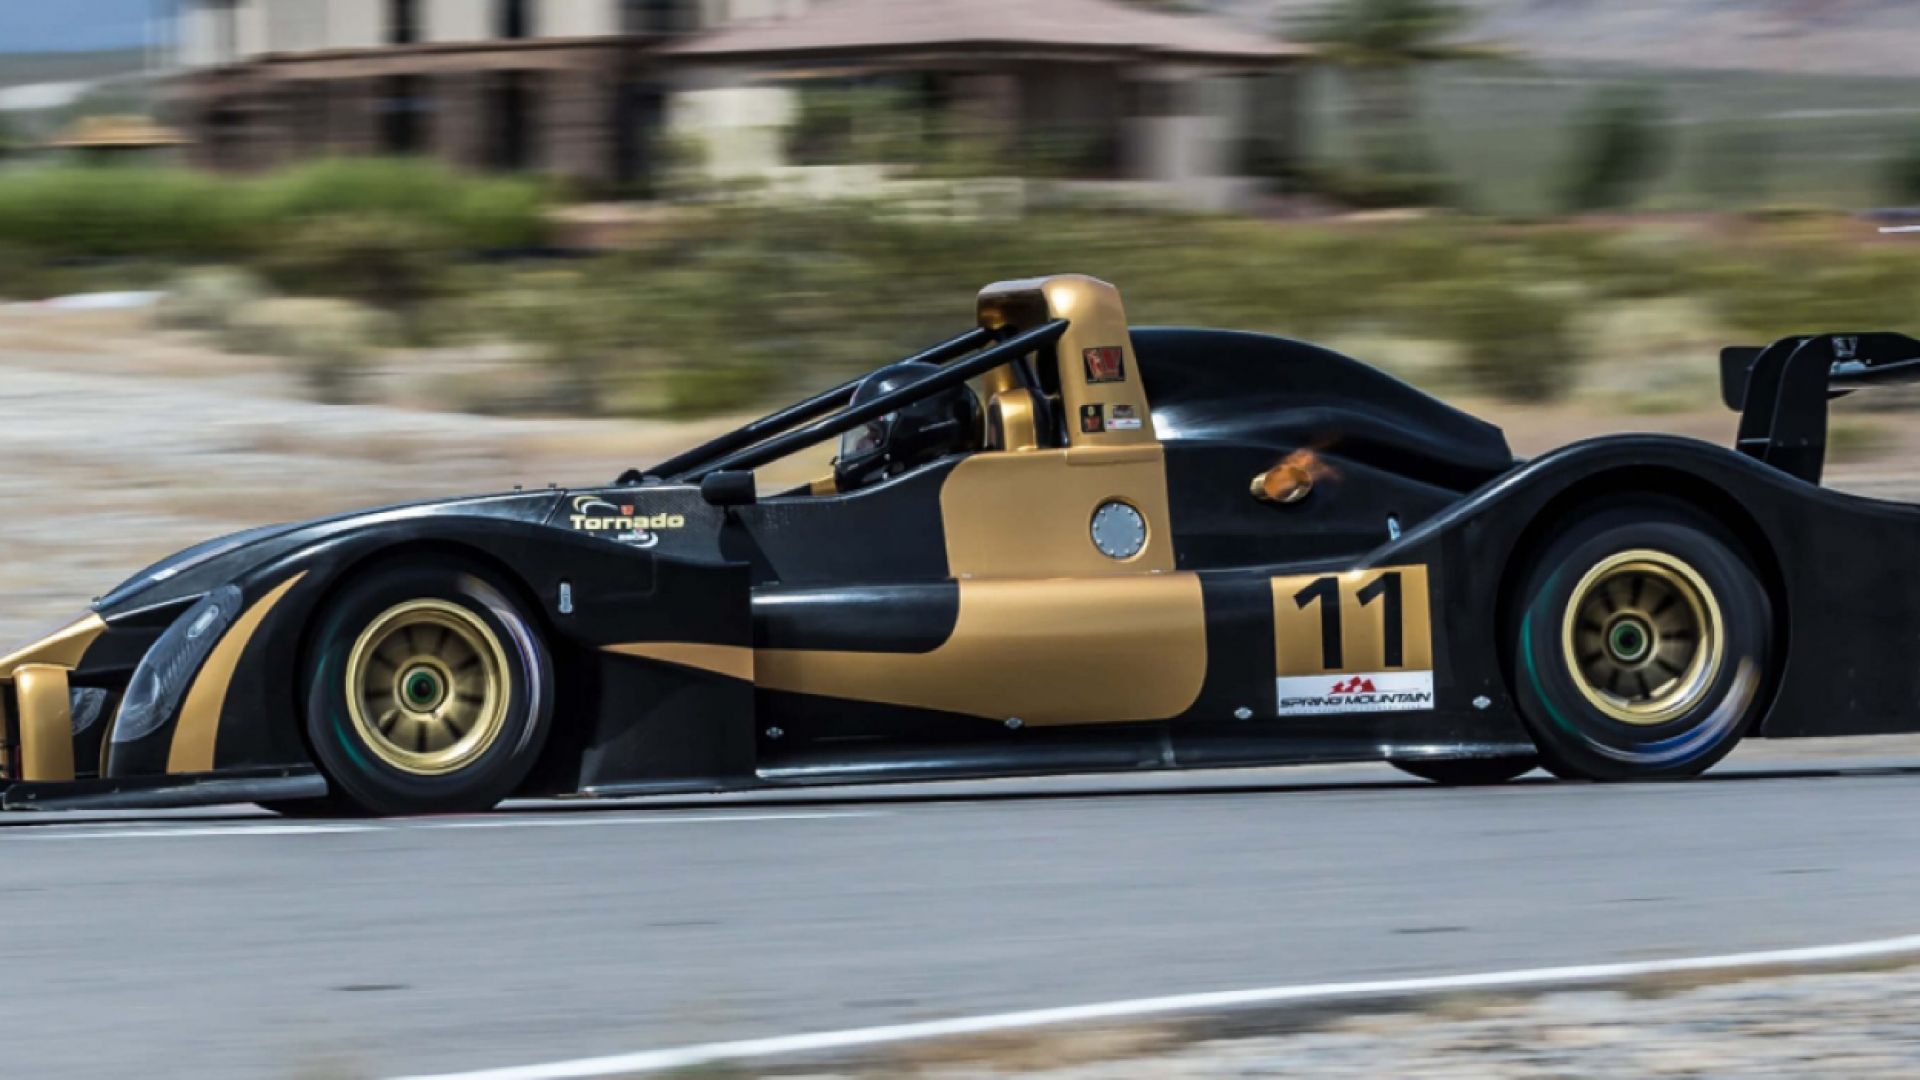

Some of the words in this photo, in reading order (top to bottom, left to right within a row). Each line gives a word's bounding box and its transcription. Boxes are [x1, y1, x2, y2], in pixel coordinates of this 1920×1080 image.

[570, 513, 685, 530] Tornado
[1294, 572, 1403, 669] 11
[1280, 696, 1342, 709] SPRING
[1345, 692, 1432, 704] MOUNTAIN
